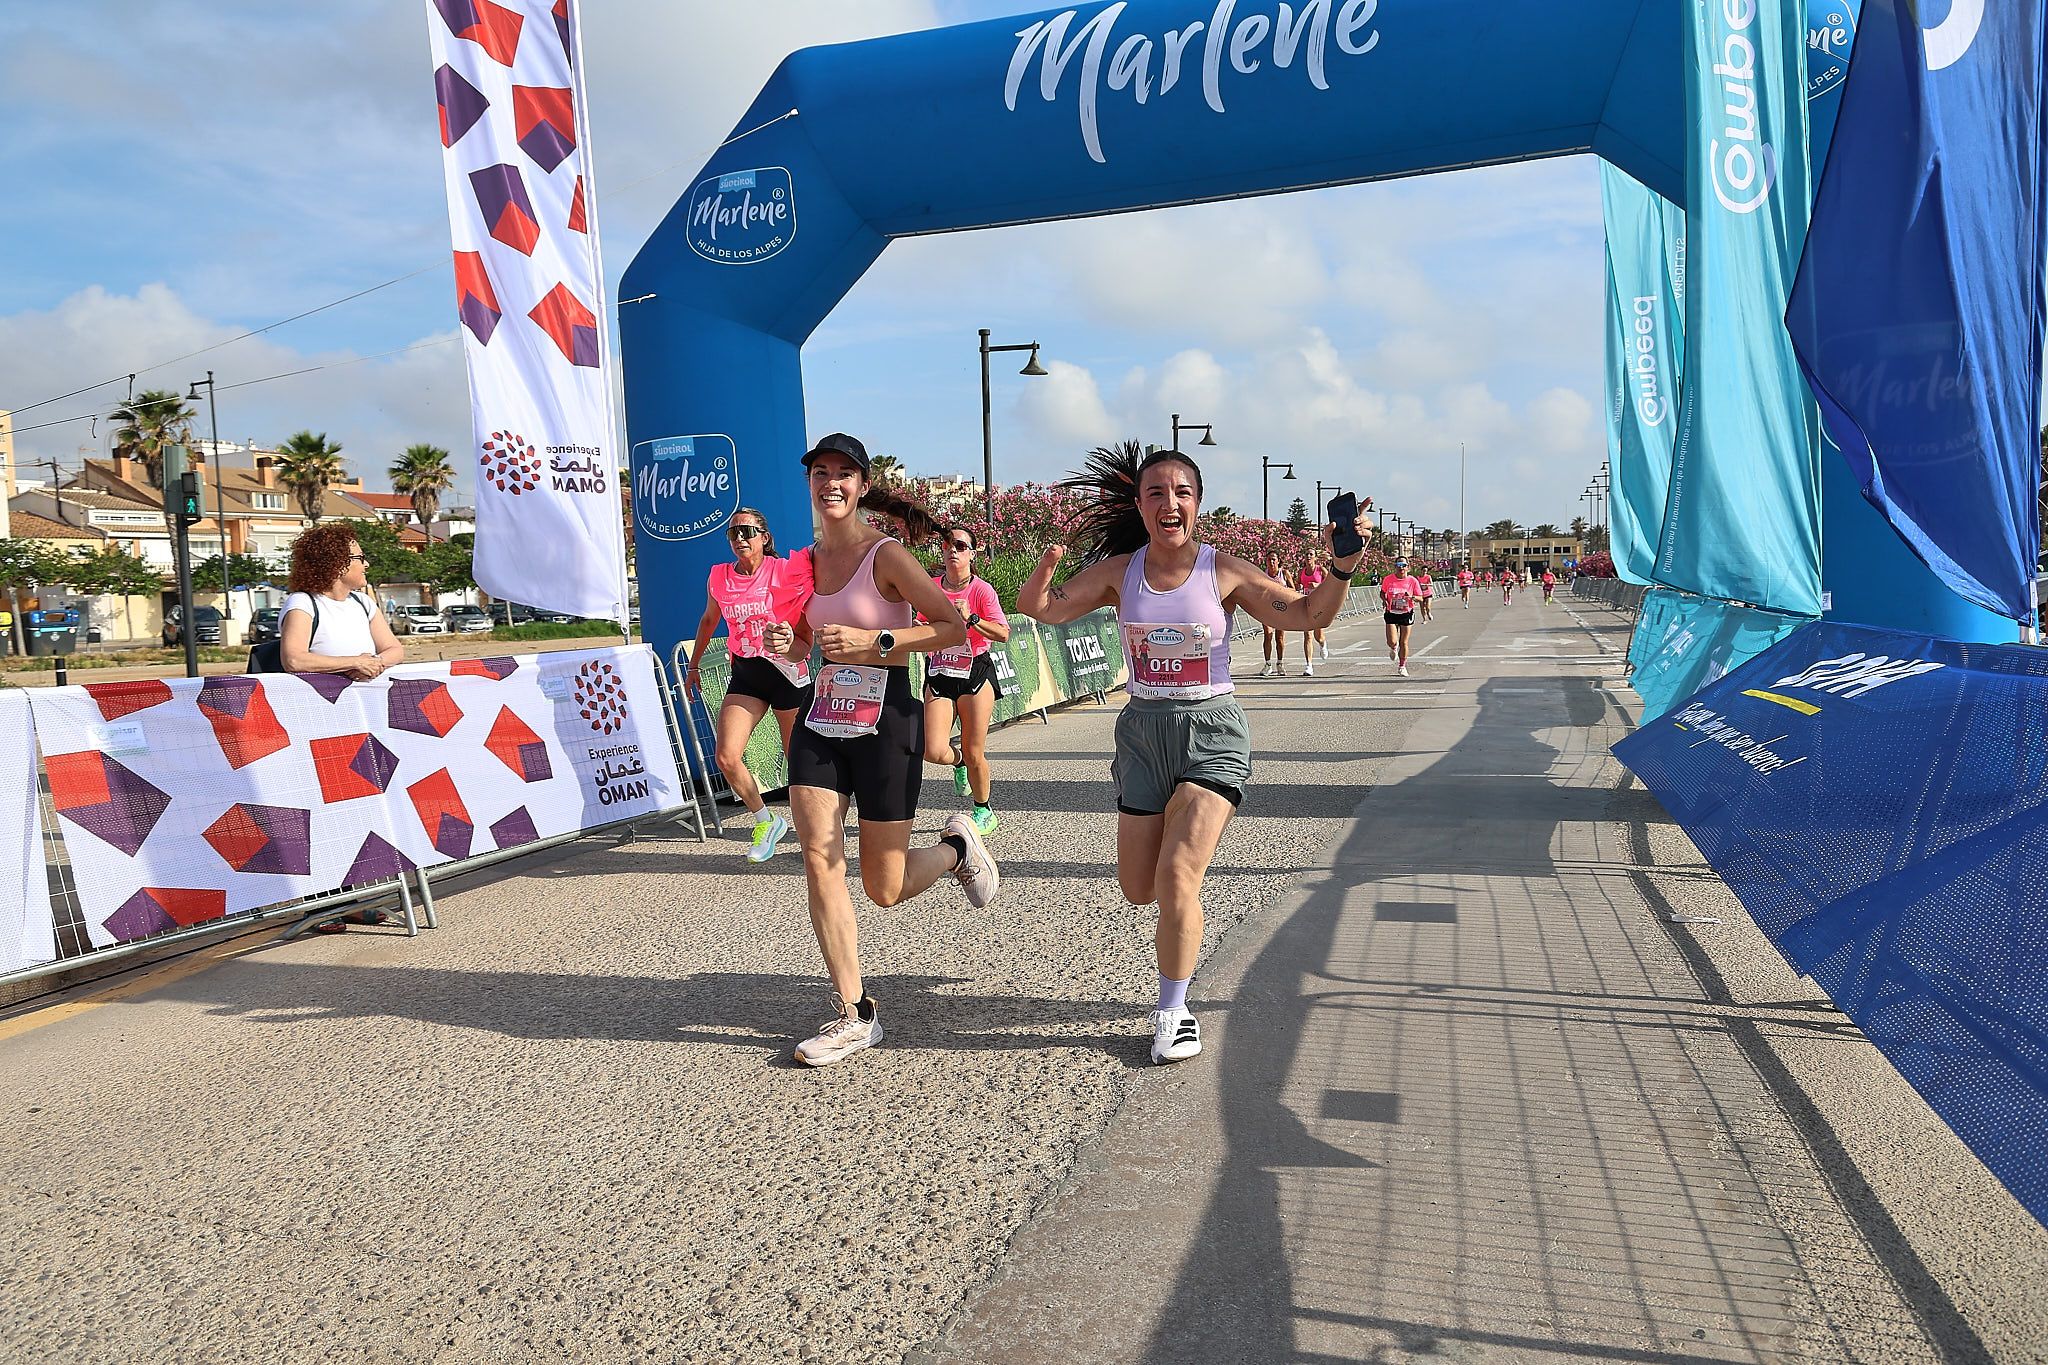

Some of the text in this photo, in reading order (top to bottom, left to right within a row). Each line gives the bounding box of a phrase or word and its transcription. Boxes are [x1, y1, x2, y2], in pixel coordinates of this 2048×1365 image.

[1004, 0, 1380, 163] Marlene
[694, 190, 787, 240] Marlene
[697, 236, 782, 258] HIJA DE LOS ALPES
[639, 459, 730, 515] Marlene
[643, 509, 723, 534] HIJA DE LOS ALPES
[724, 601, 768, 619] CARRERA
[942, 654, 959, 662] 016
[1150, 659, 1183, 672] 016
[831, 698, 856, 711] 016
[588, 744, 639, 760] Experience
[1738, 734, 1808, 776] bueno!
[598, 779, 650, 805] OMAN
